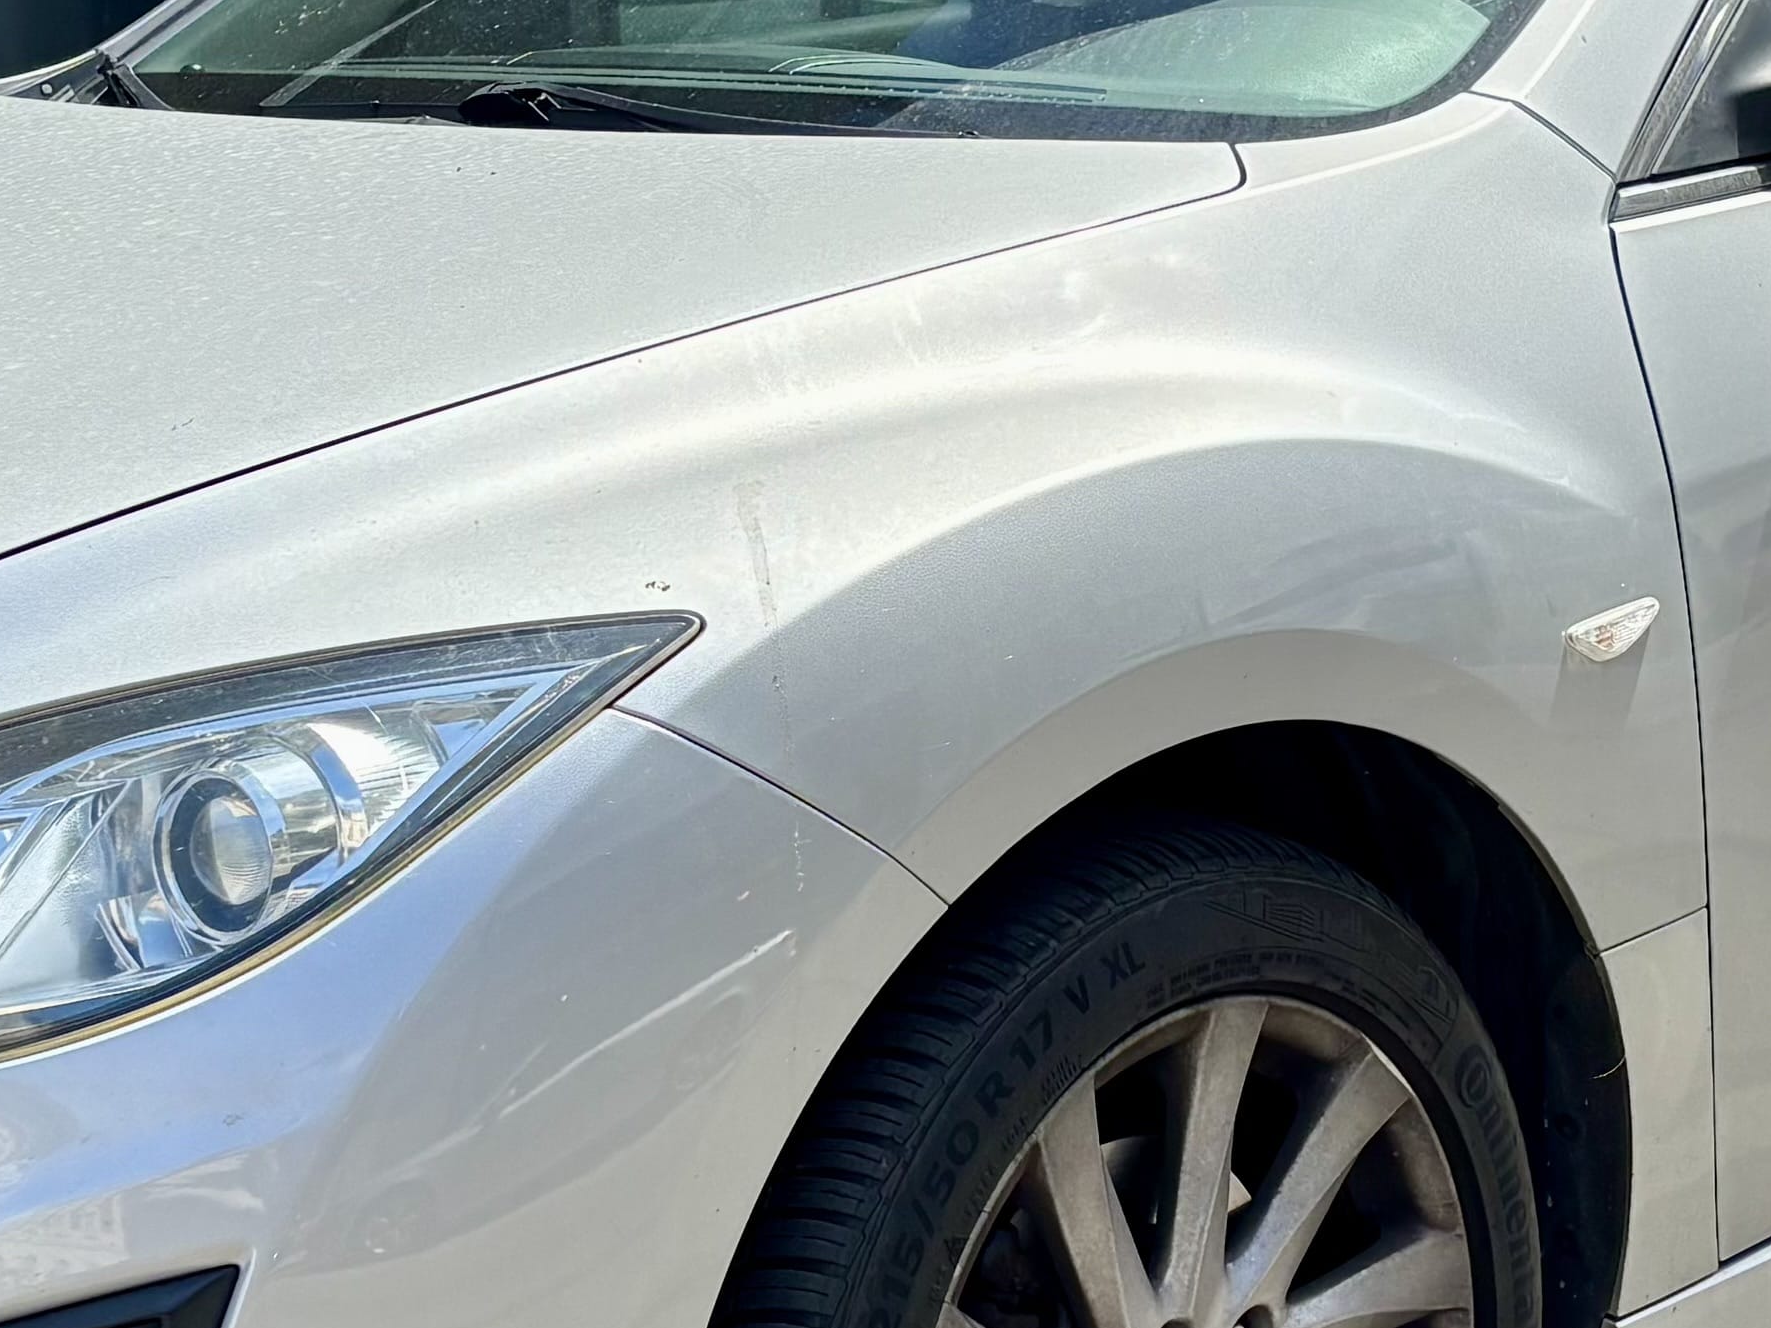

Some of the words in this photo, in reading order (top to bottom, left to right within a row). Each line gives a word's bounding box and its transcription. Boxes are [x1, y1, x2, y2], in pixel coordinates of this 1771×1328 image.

[972, 1071, 1015, 1120] R
[1010, 1010, 1054, 1069] 17
[1062, 974, 1092, 1015] V
[1100, 941, 1147, 989] XL
